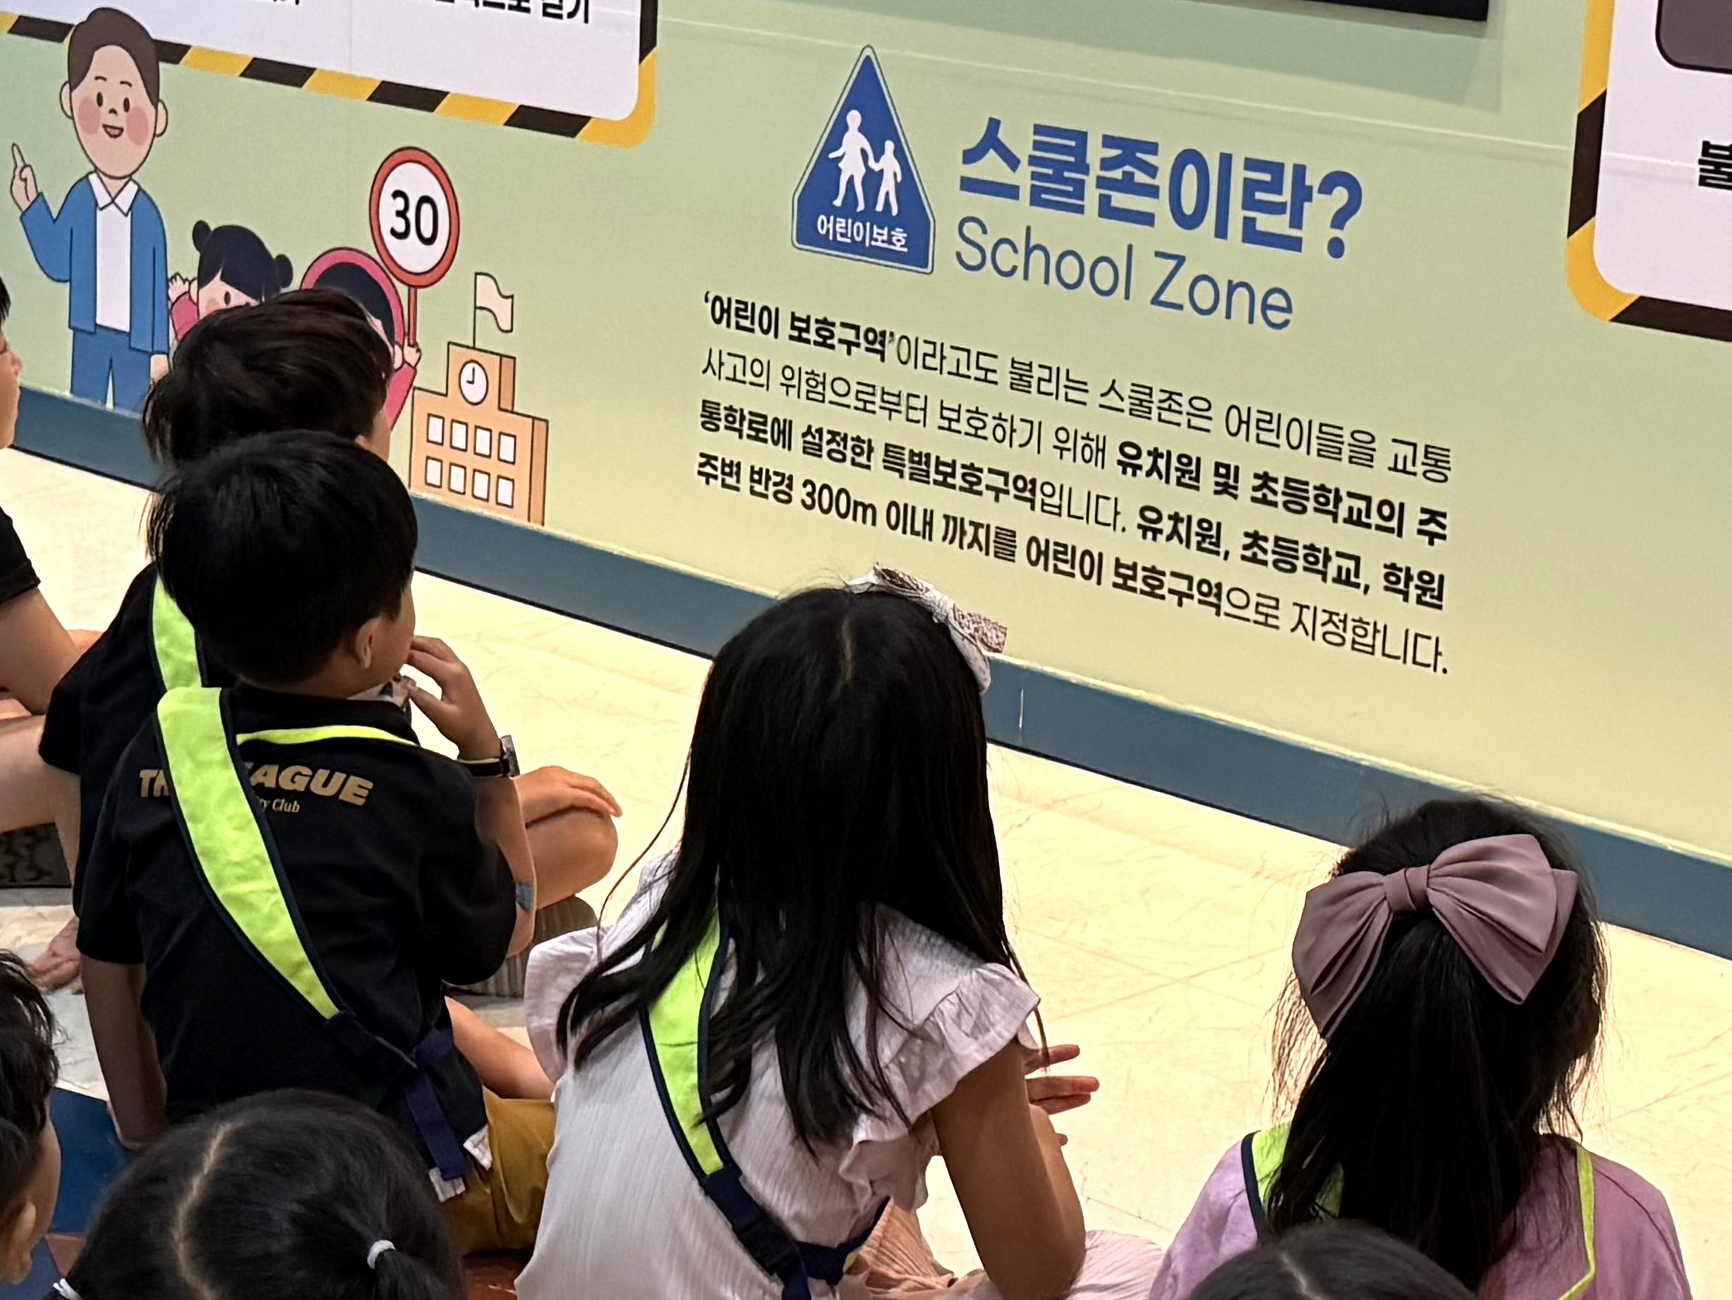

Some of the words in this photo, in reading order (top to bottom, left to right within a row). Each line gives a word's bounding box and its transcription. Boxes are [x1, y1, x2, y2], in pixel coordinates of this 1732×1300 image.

[390, 190, 439, 246] 30
[816, 213, 909, 253] 어린이보호
[959, 117, 1363, 260] 스쿨존이란?
[955, 216, 1134, 302] School
[1149, 250, 1294, 331] Zone
[701, 347, 771, 392] 사고의
[779, 364, 929, 428] 위험으로부터
[937, 398, 1044, 455] 보호하기
[1052, 424, 1107, 470] 위해
[1116, 440, 1202, 492] 유치원
[1212, 460, 1240, 501] 및
[1250, 470, 1406, 539] 초등학교의
[1416, 506, 1448, 547] 주
[1009, 357, 1089, 406] 불리는
[1098, 378, 1214, 434] 스쿨존은
[1224, 403, 1377, 469] 어린이들을
[1387, 437, 1452, 484] 교통
[696, 451, 742, 492] 주변
[748, 464, 794, 505] 반경
[800, 478, 877, 527] 300m
[885, 500, 934, 543] 이내
[941, 513, 1018, 564] 까지를
[1026, 535, 1104, 587] 어린이
[1111, 556, 1281, 631] 보호구역으로
[1289, 600, 1449, 676] 지정합니다.
[700, 398, 793, 452] 통학로에
[801, 423, 875, 471] 설정한
[881, 442, 1127, 533] 특별보호구역입니다.
[1136, 504, 1230, 562] 유치원,
[1239, 529, 1371, 596] 초등학교,
[1382, 561, 1445, 612] 학원
[271, 798, 301, 814] Club
